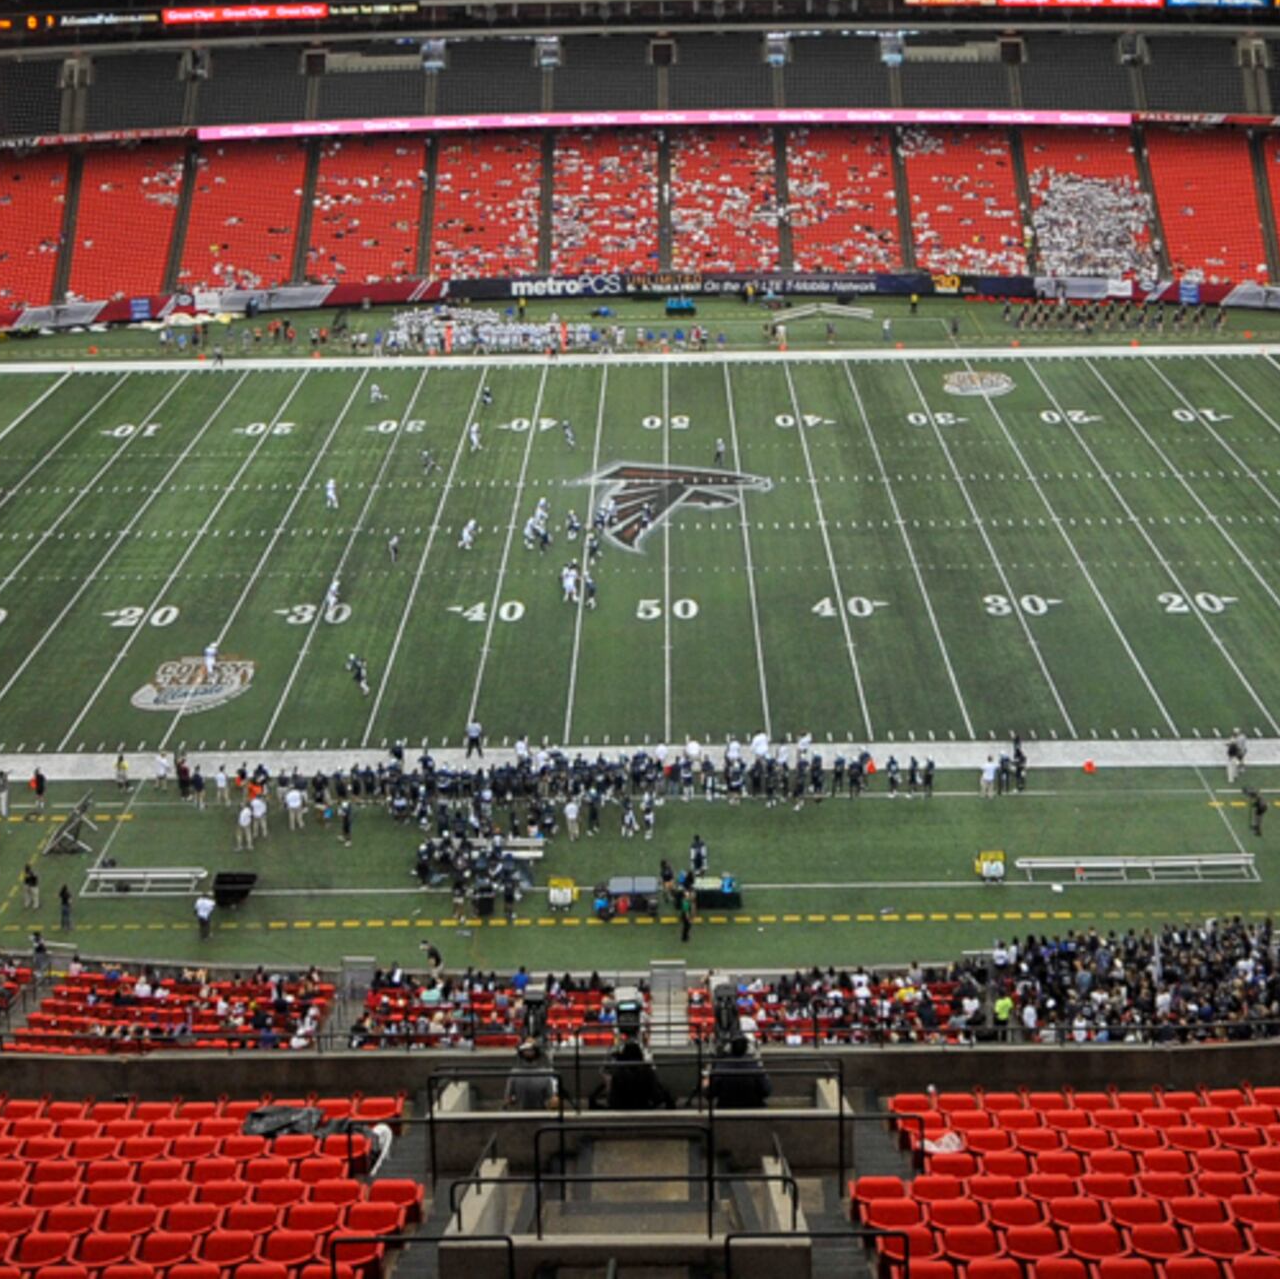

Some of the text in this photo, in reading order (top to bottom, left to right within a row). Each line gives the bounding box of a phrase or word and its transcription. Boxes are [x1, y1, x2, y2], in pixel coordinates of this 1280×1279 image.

[512, 275, 620, 296] metroPCS
[461, 601, 525, 622] 40
[637, 599, 698, 620] 50
[812, 596, 875, 616] 40
[984, 593, 1051, 616] 30
[1158, 591, 1227, 614] 20
[111, 605, 179, 627] 20
[285, 603, 352, 624] 30
